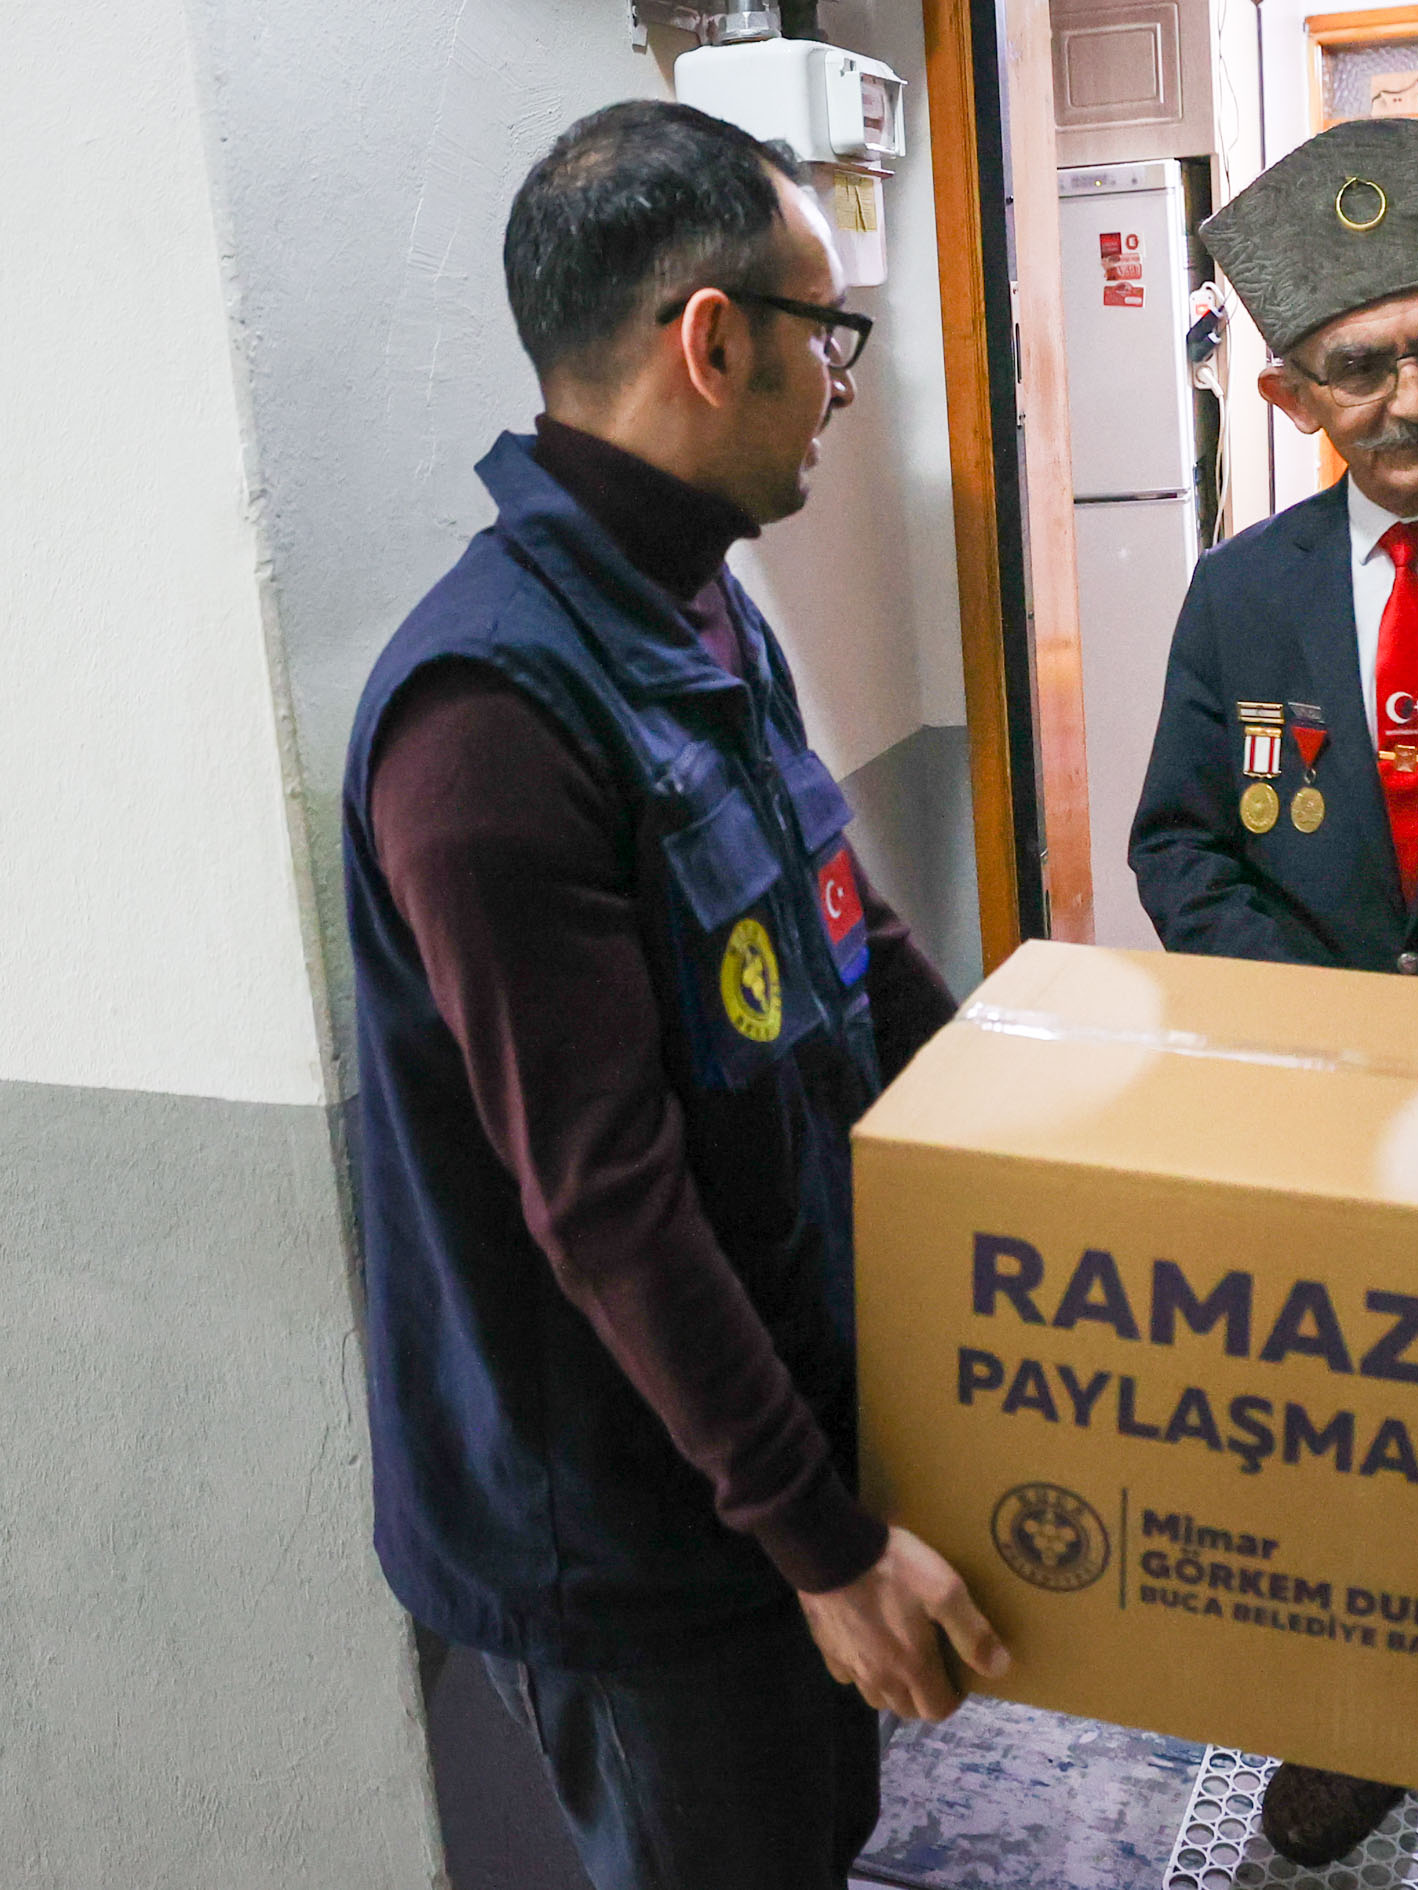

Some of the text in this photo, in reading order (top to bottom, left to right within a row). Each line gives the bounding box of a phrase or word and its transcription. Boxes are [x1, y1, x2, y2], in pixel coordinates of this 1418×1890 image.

[1140, 1508, 1280, 1561] Mimar
[1139, 1547, 1333, 1611] GÖRKEM
[1139, 1584, 1224, 1618] BUCA
[1232, 1602, 1378, 1648] BELEDİYE
